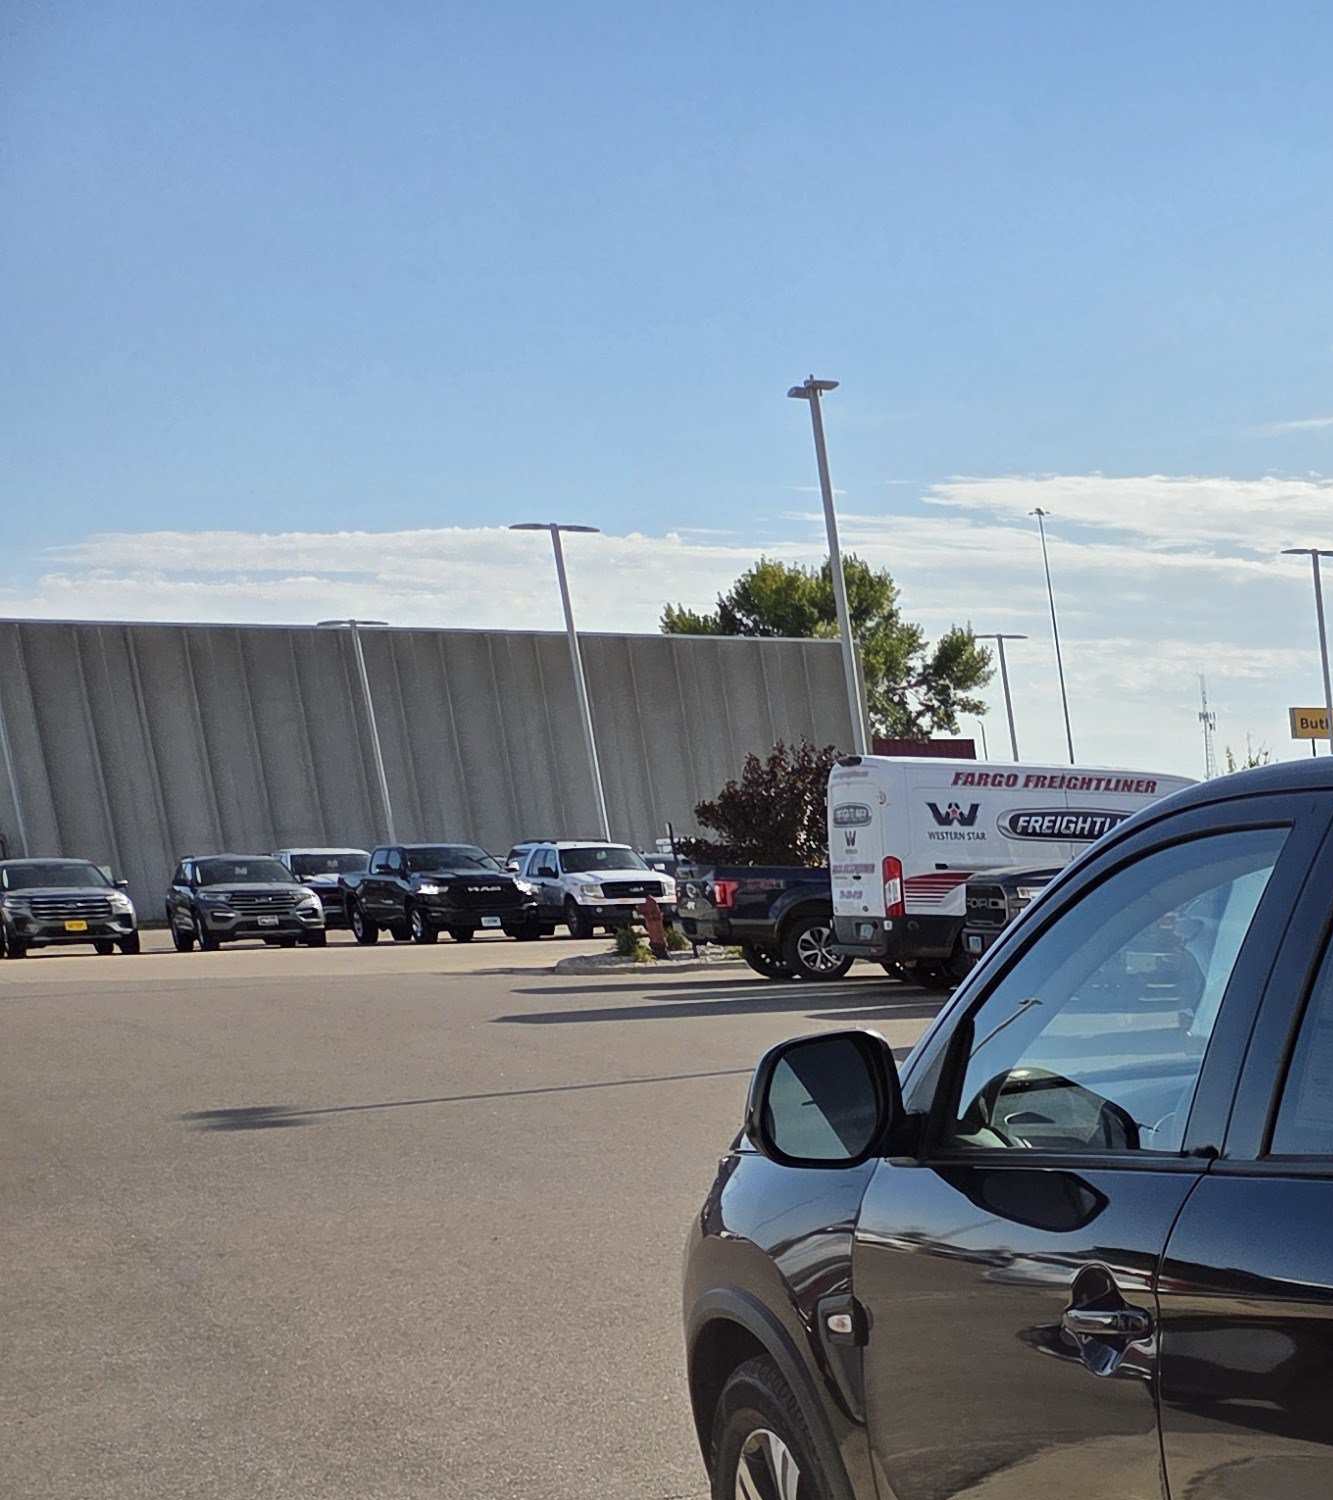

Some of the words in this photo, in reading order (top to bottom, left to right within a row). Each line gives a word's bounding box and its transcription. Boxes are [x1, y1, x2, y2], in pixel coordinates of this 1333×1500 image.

[951, 772, 1018, 788] FARGO
[1021, 774, 1157, 794] FREIGHTLINER
[928, 831, 965, 841] WESTERN
[967, 831, 986, 841] STAR
